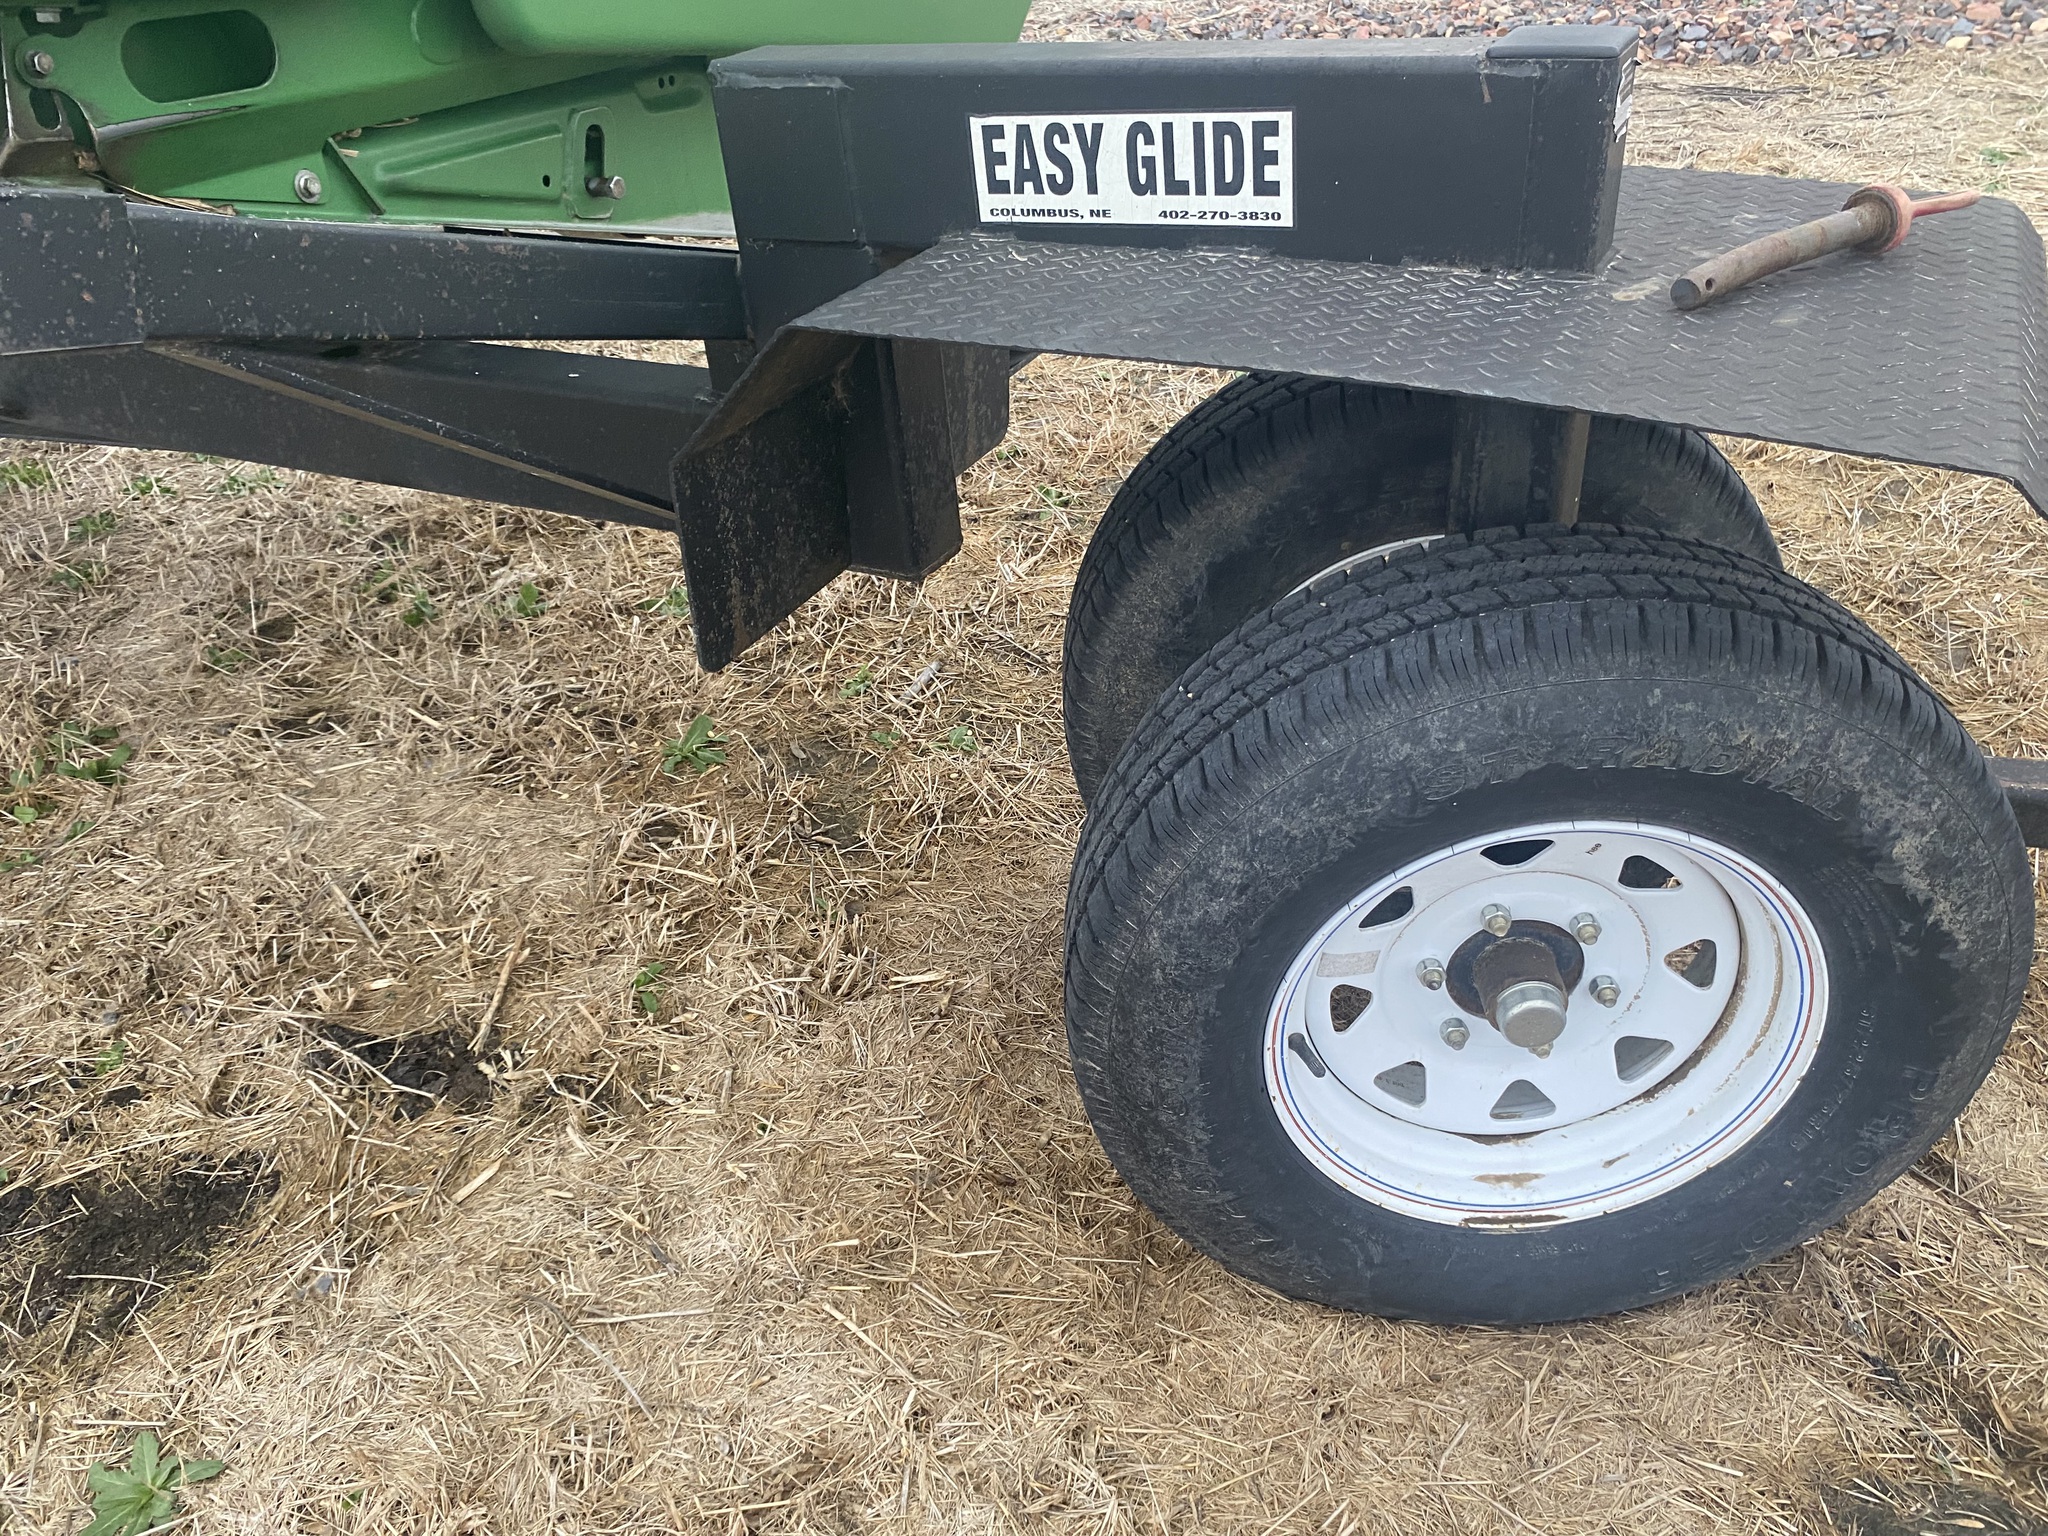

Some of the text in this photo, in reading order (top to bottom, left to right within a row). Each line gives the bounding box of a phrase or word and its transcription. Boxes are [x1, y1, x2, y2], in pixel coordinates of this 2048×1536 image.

[981, 120, 1281, 197] EASY GLIDE
[989, 207, 1282, 222] COLUMBUS, NE 402-270-3830
